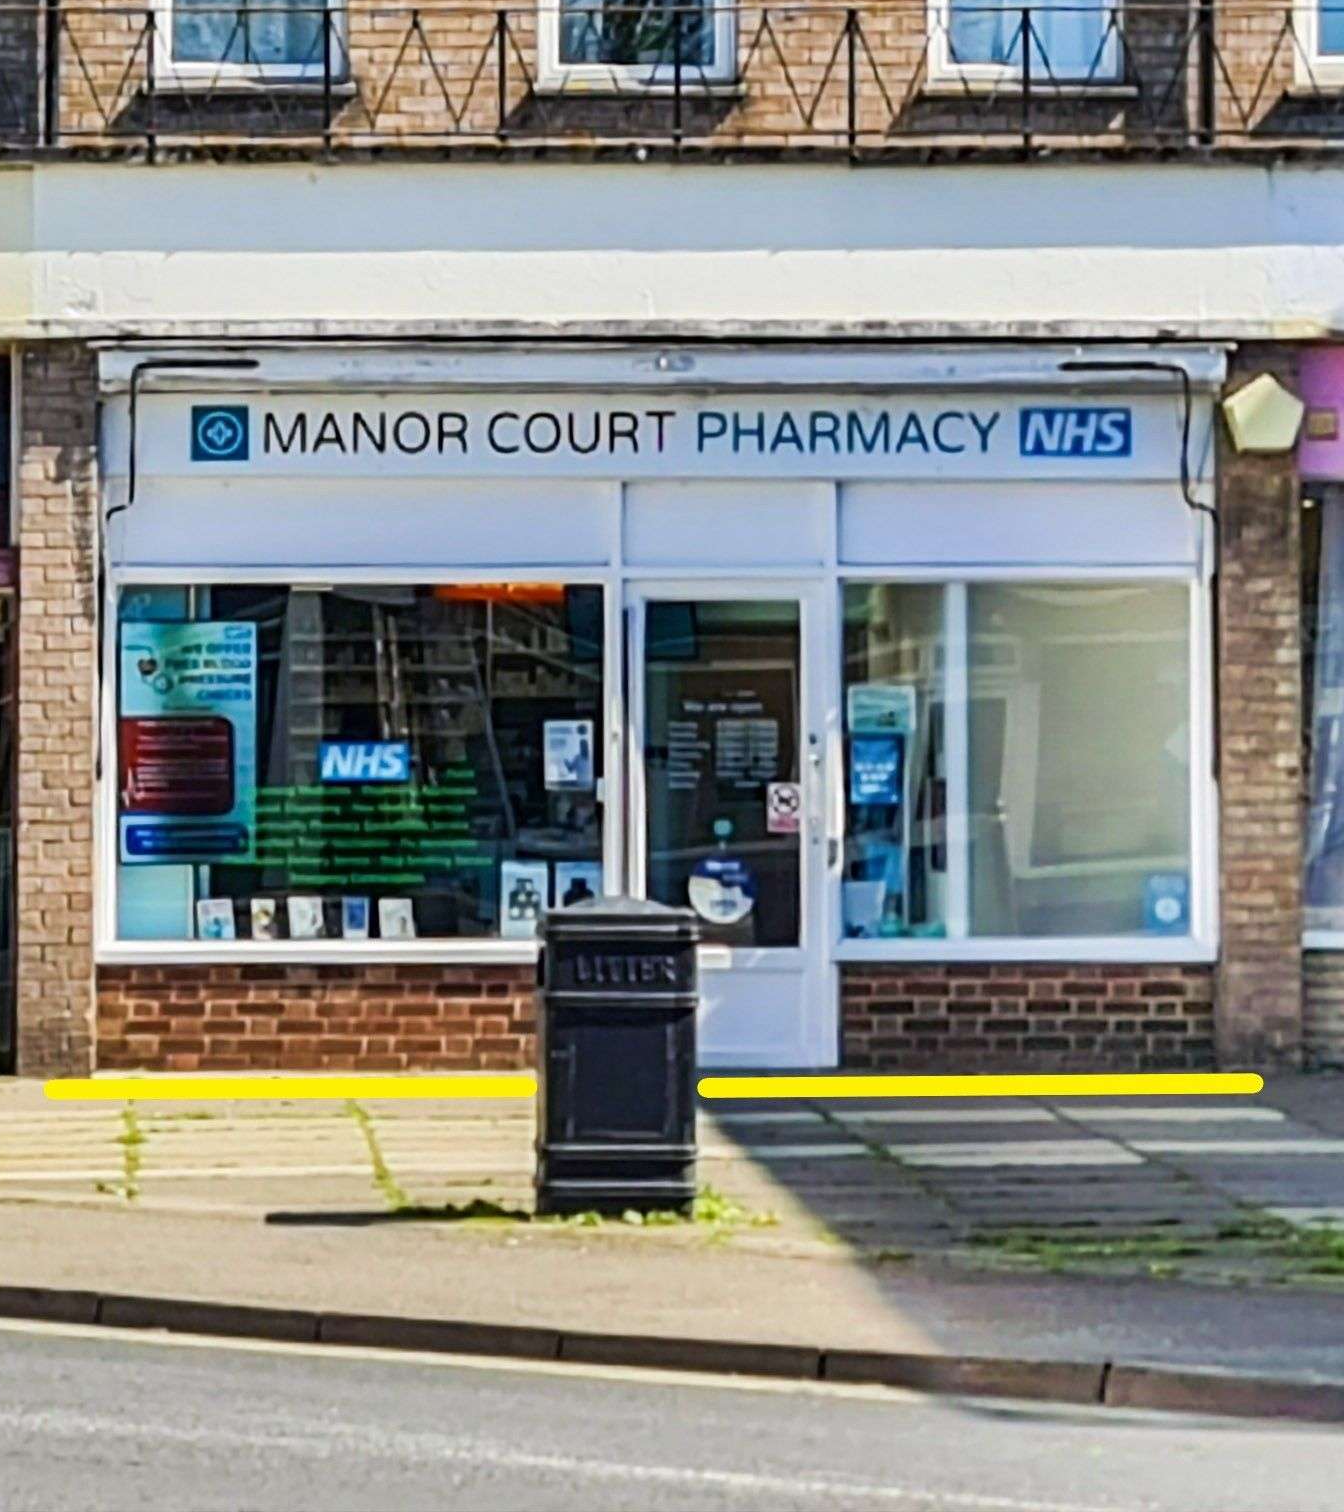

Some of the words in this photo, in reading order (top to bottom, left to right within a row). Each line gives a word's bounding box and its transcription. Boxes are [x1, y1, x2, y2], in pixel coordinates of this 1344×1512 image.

[263, 411, 468, 455] MANOR
[487, 411, 676, 455] COURT
[697, 411, 1000, 454] PHARMACY
[1024, 412, 1126, 453] NHS
[321, 745, 404, 780] NHS
